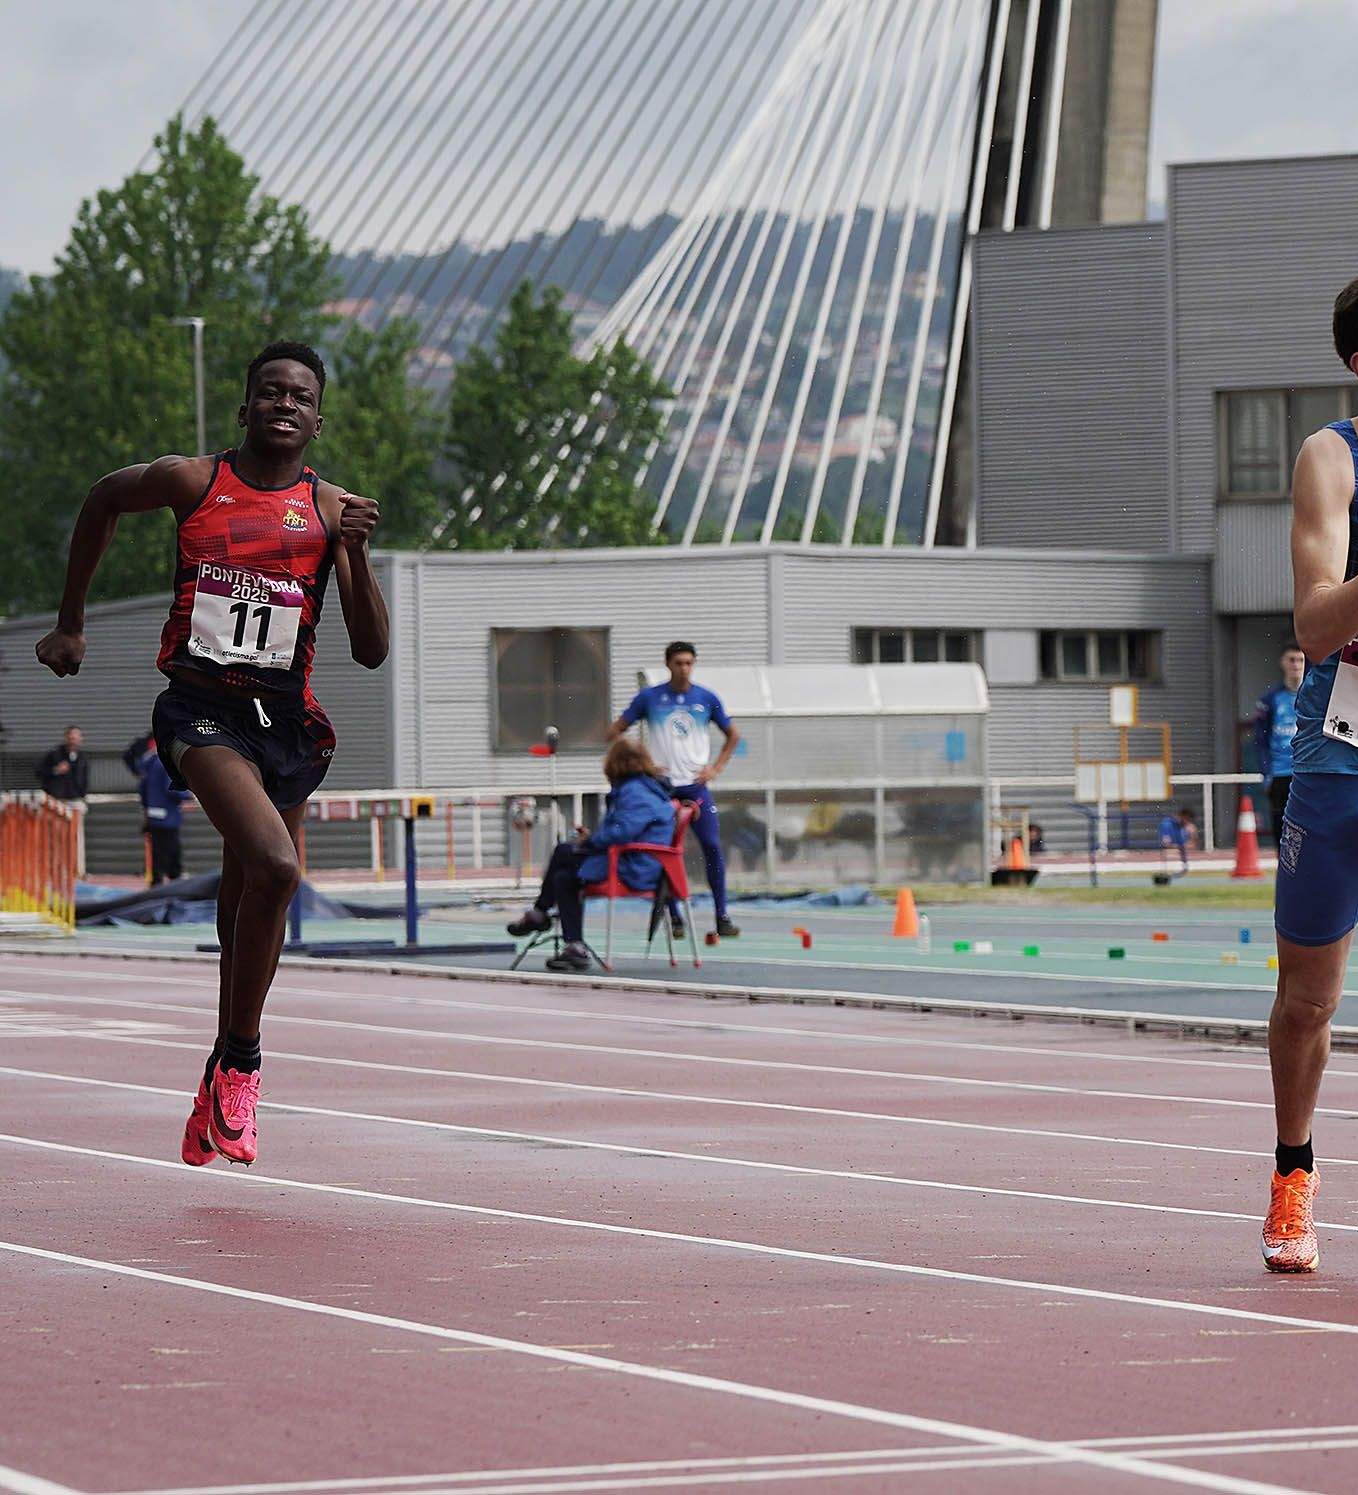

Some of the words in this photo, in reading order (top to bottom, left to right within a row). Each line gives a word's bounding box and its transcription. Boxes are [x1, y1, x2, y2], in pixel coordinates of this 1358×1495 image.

[201, 563, 303, 594] PONTEVEDRA
[231, 584, 269, 603] 2025
[229, 602, 272, 651] 11
